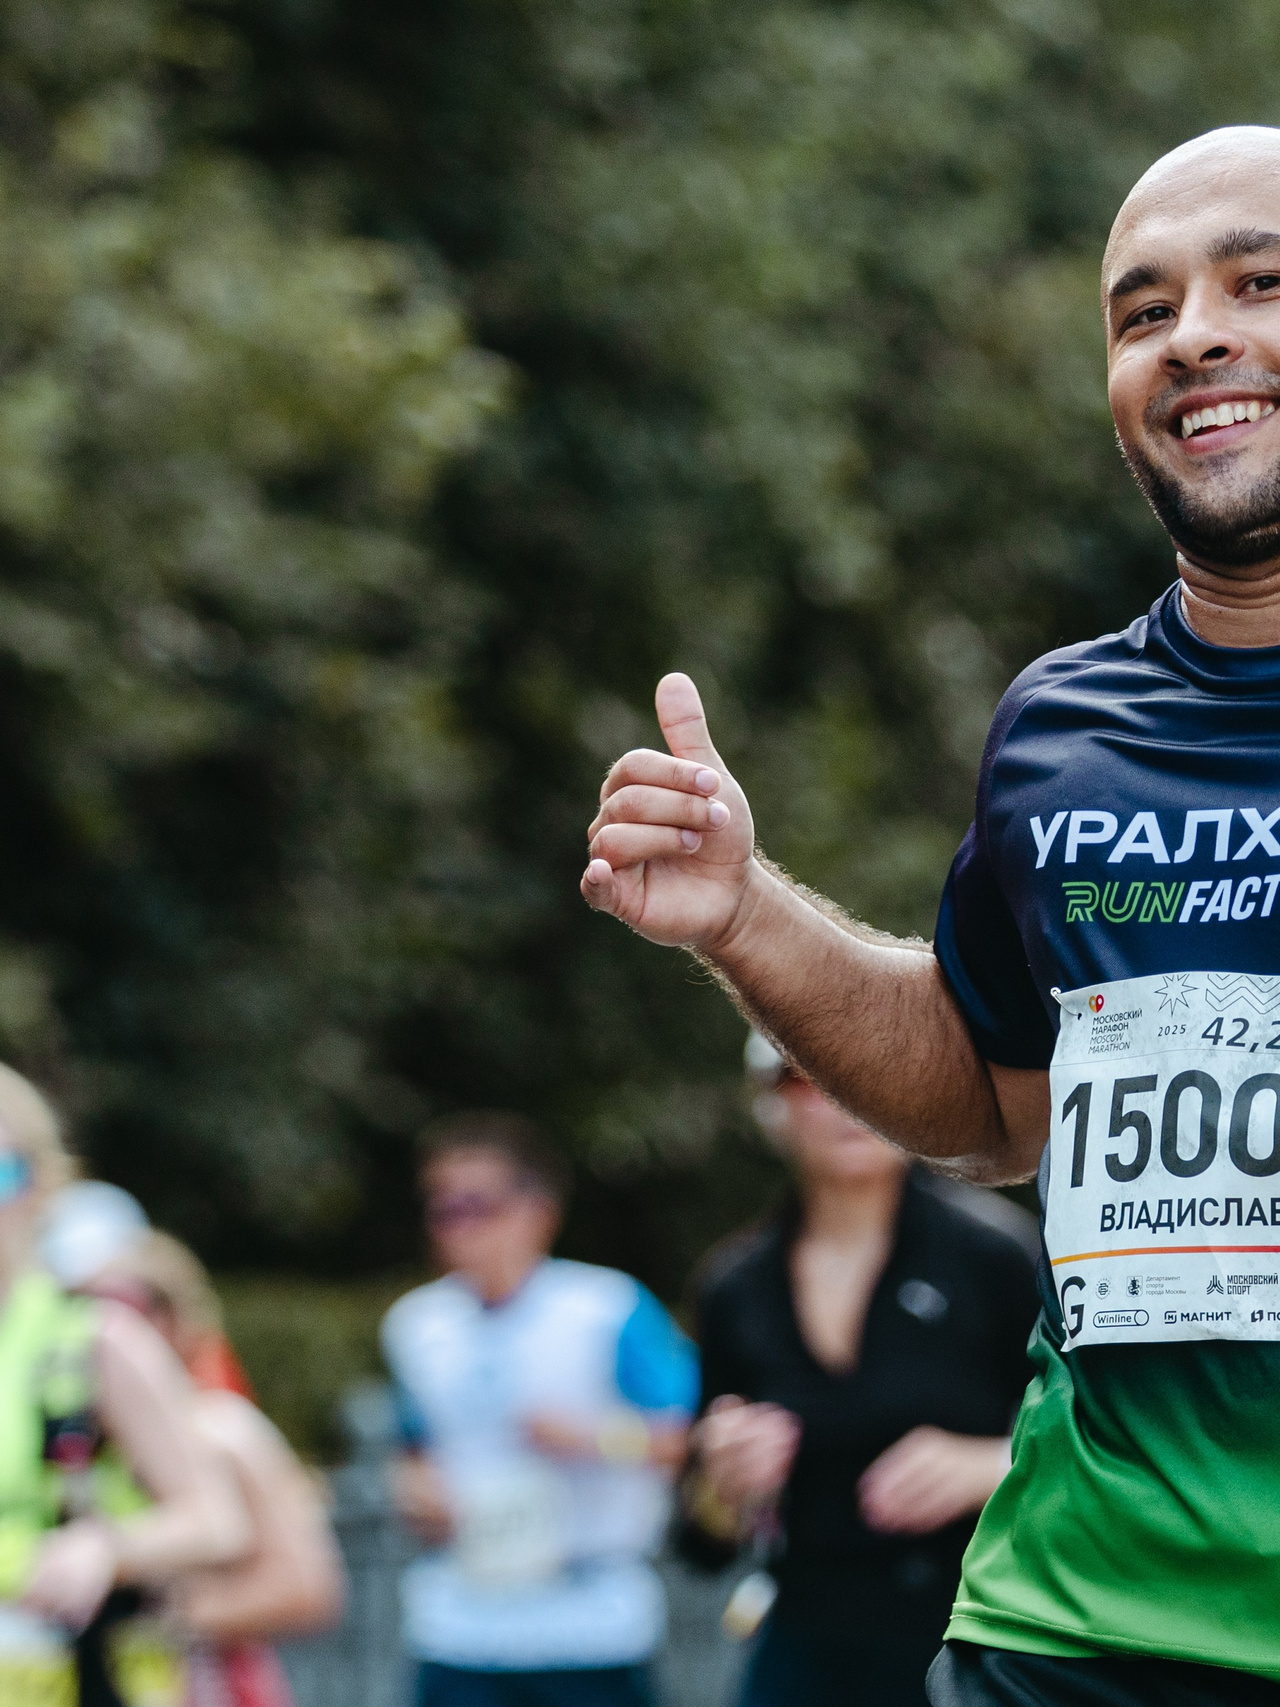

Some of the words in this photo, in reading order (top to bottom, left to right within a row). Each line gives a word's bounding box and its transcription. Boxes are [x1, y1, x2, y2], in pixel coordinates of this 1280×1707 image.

[1093, 1009, 1143, 1025] МОСКОВСКИЙ
[1092, 1022, 1129, 1035] МАРАФОН
[1157, 1024, 1187, 1037] 2025
[1090, 1033, 1124, 1044] MOSCOW
[1089, 1042, 1130, 1053] MARATHON
[1227, 1273, 1278, 1285] МОСКОВСКИЙ
[1227, 1285, 1251, 1295] СПОРТ
[1061, 1276, 1086, 1339] G
[1097, 1314, 1132, 1324] Winline
[1181, 1311, 1232, 1321] МАГНИТ
